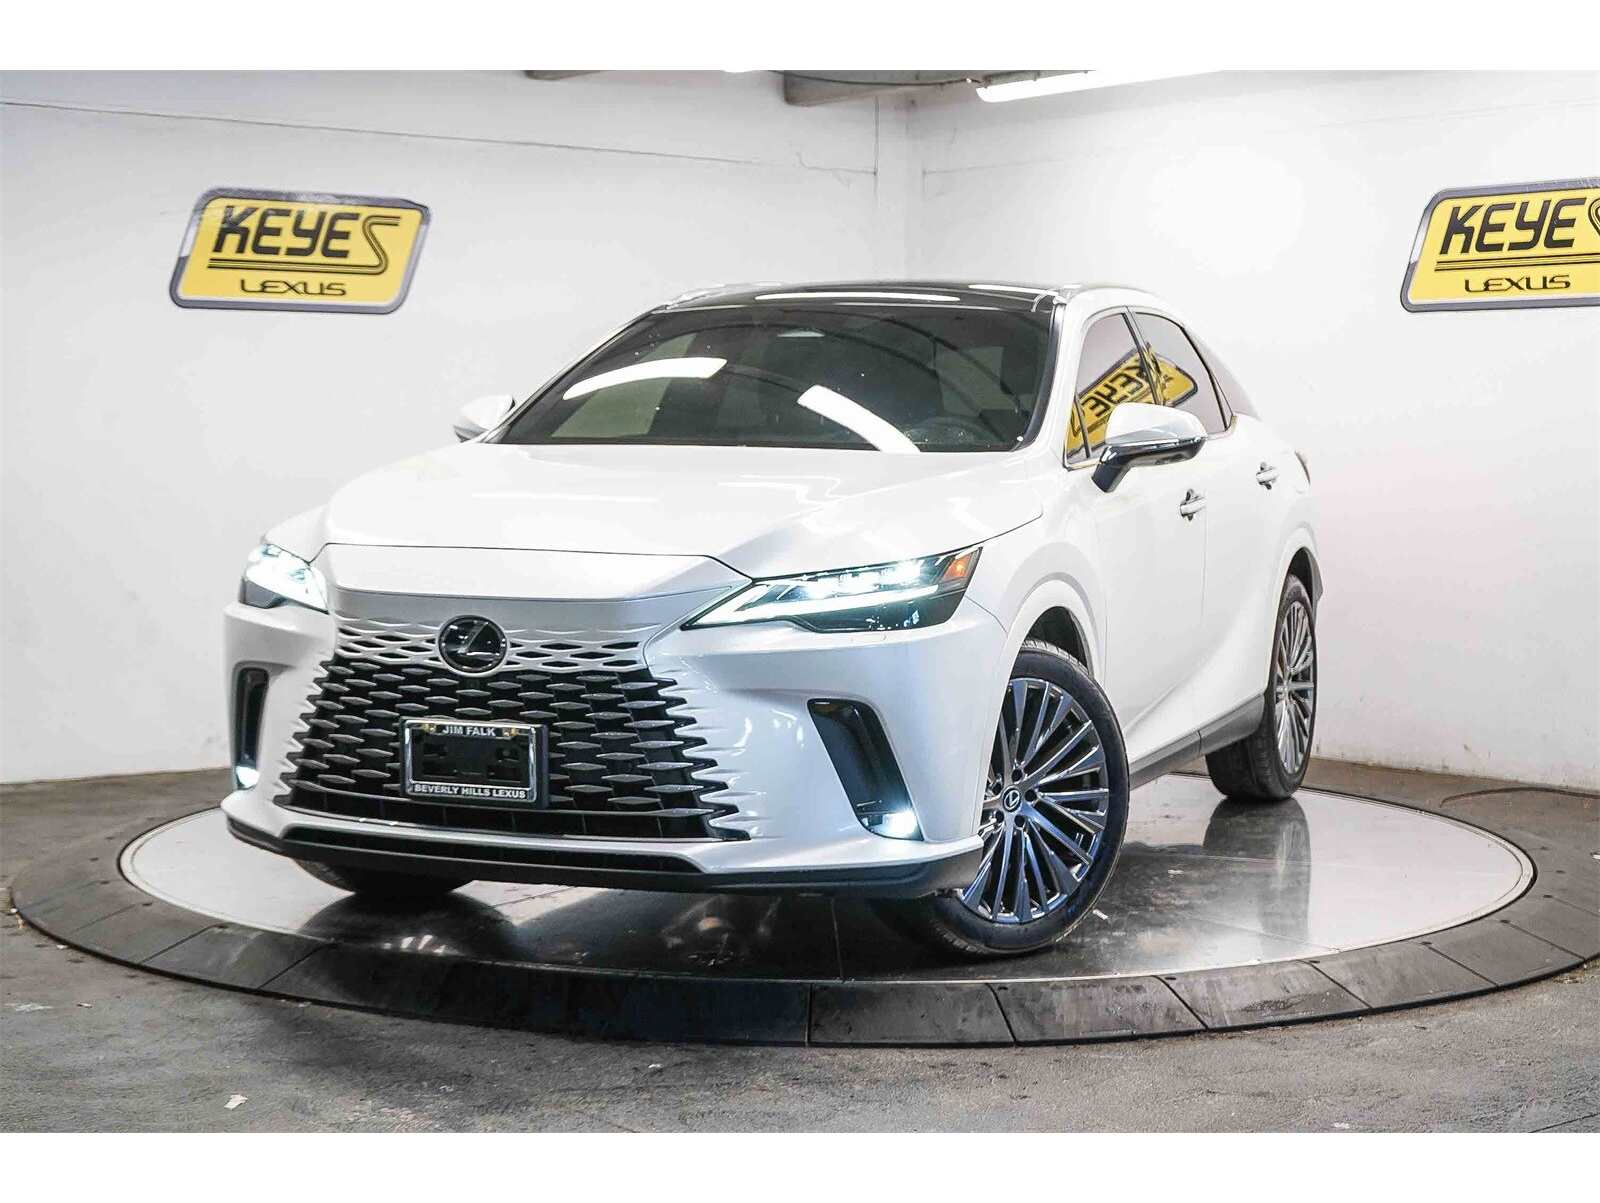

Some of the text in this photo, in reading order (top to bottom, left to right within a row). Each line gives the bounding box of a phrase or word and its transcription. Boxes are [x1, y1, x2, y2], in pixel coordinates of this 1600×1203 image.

[1437, 197, 1600, 256] KEYE
[208, 204, 402, 275] KEYES
[240, 279, 346, 296] LEXUS
[1464, 274, 1571, 292] LEXUS
[442, 725, 496, 737] JIM FALK
[414, 784, 526, 799] BEVERLY HILLS LEXUS
